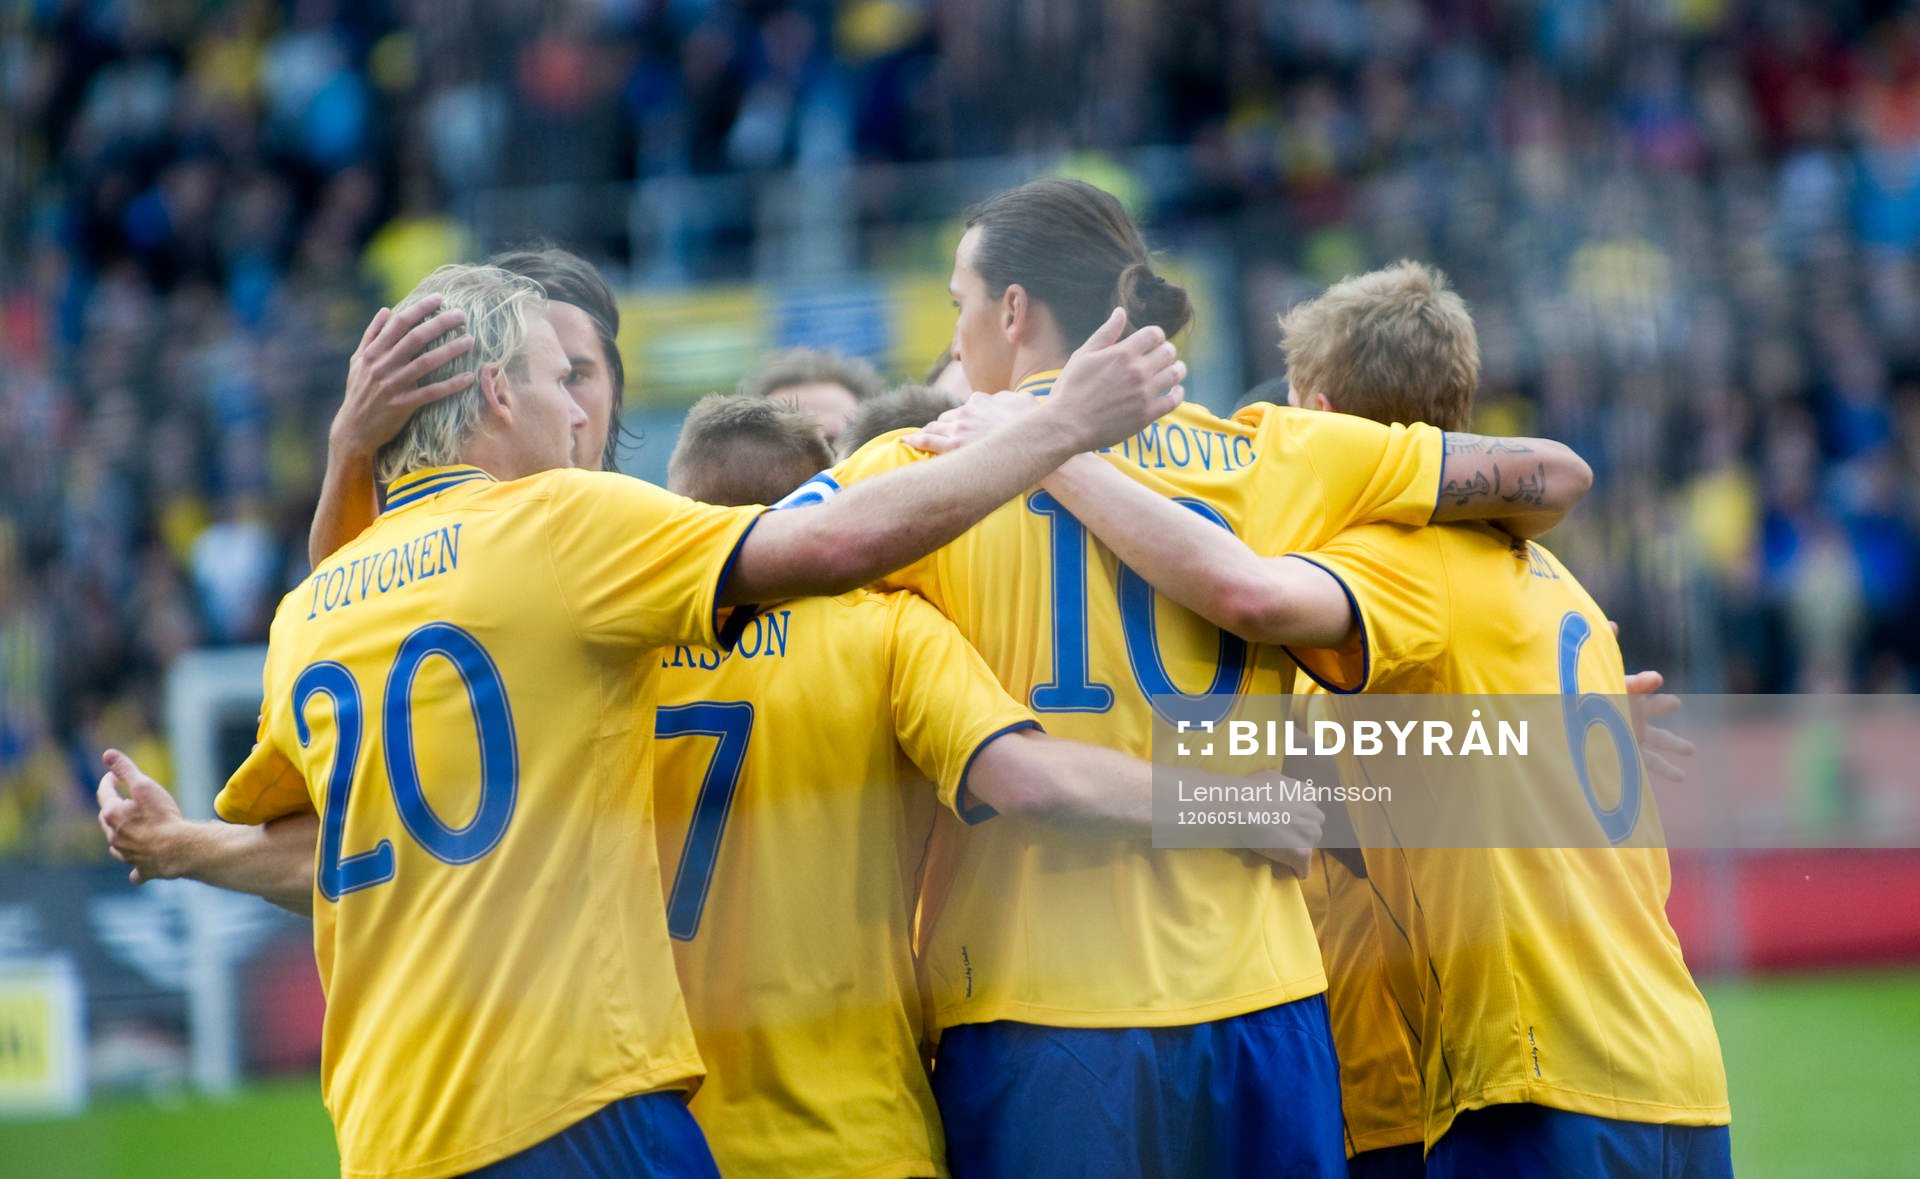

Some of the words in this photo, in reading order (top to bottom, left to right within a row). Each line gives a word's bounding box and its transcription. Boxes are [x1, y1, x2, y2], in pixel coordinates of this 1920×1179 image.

[307, 523, 462, 621] TOIVONEN
[1027, 488, 1247, 731] 10
[292, 621, 519, 903] 20
[654, 701, 754, 942] 7
[1558, 611, 1642, 845] 6
